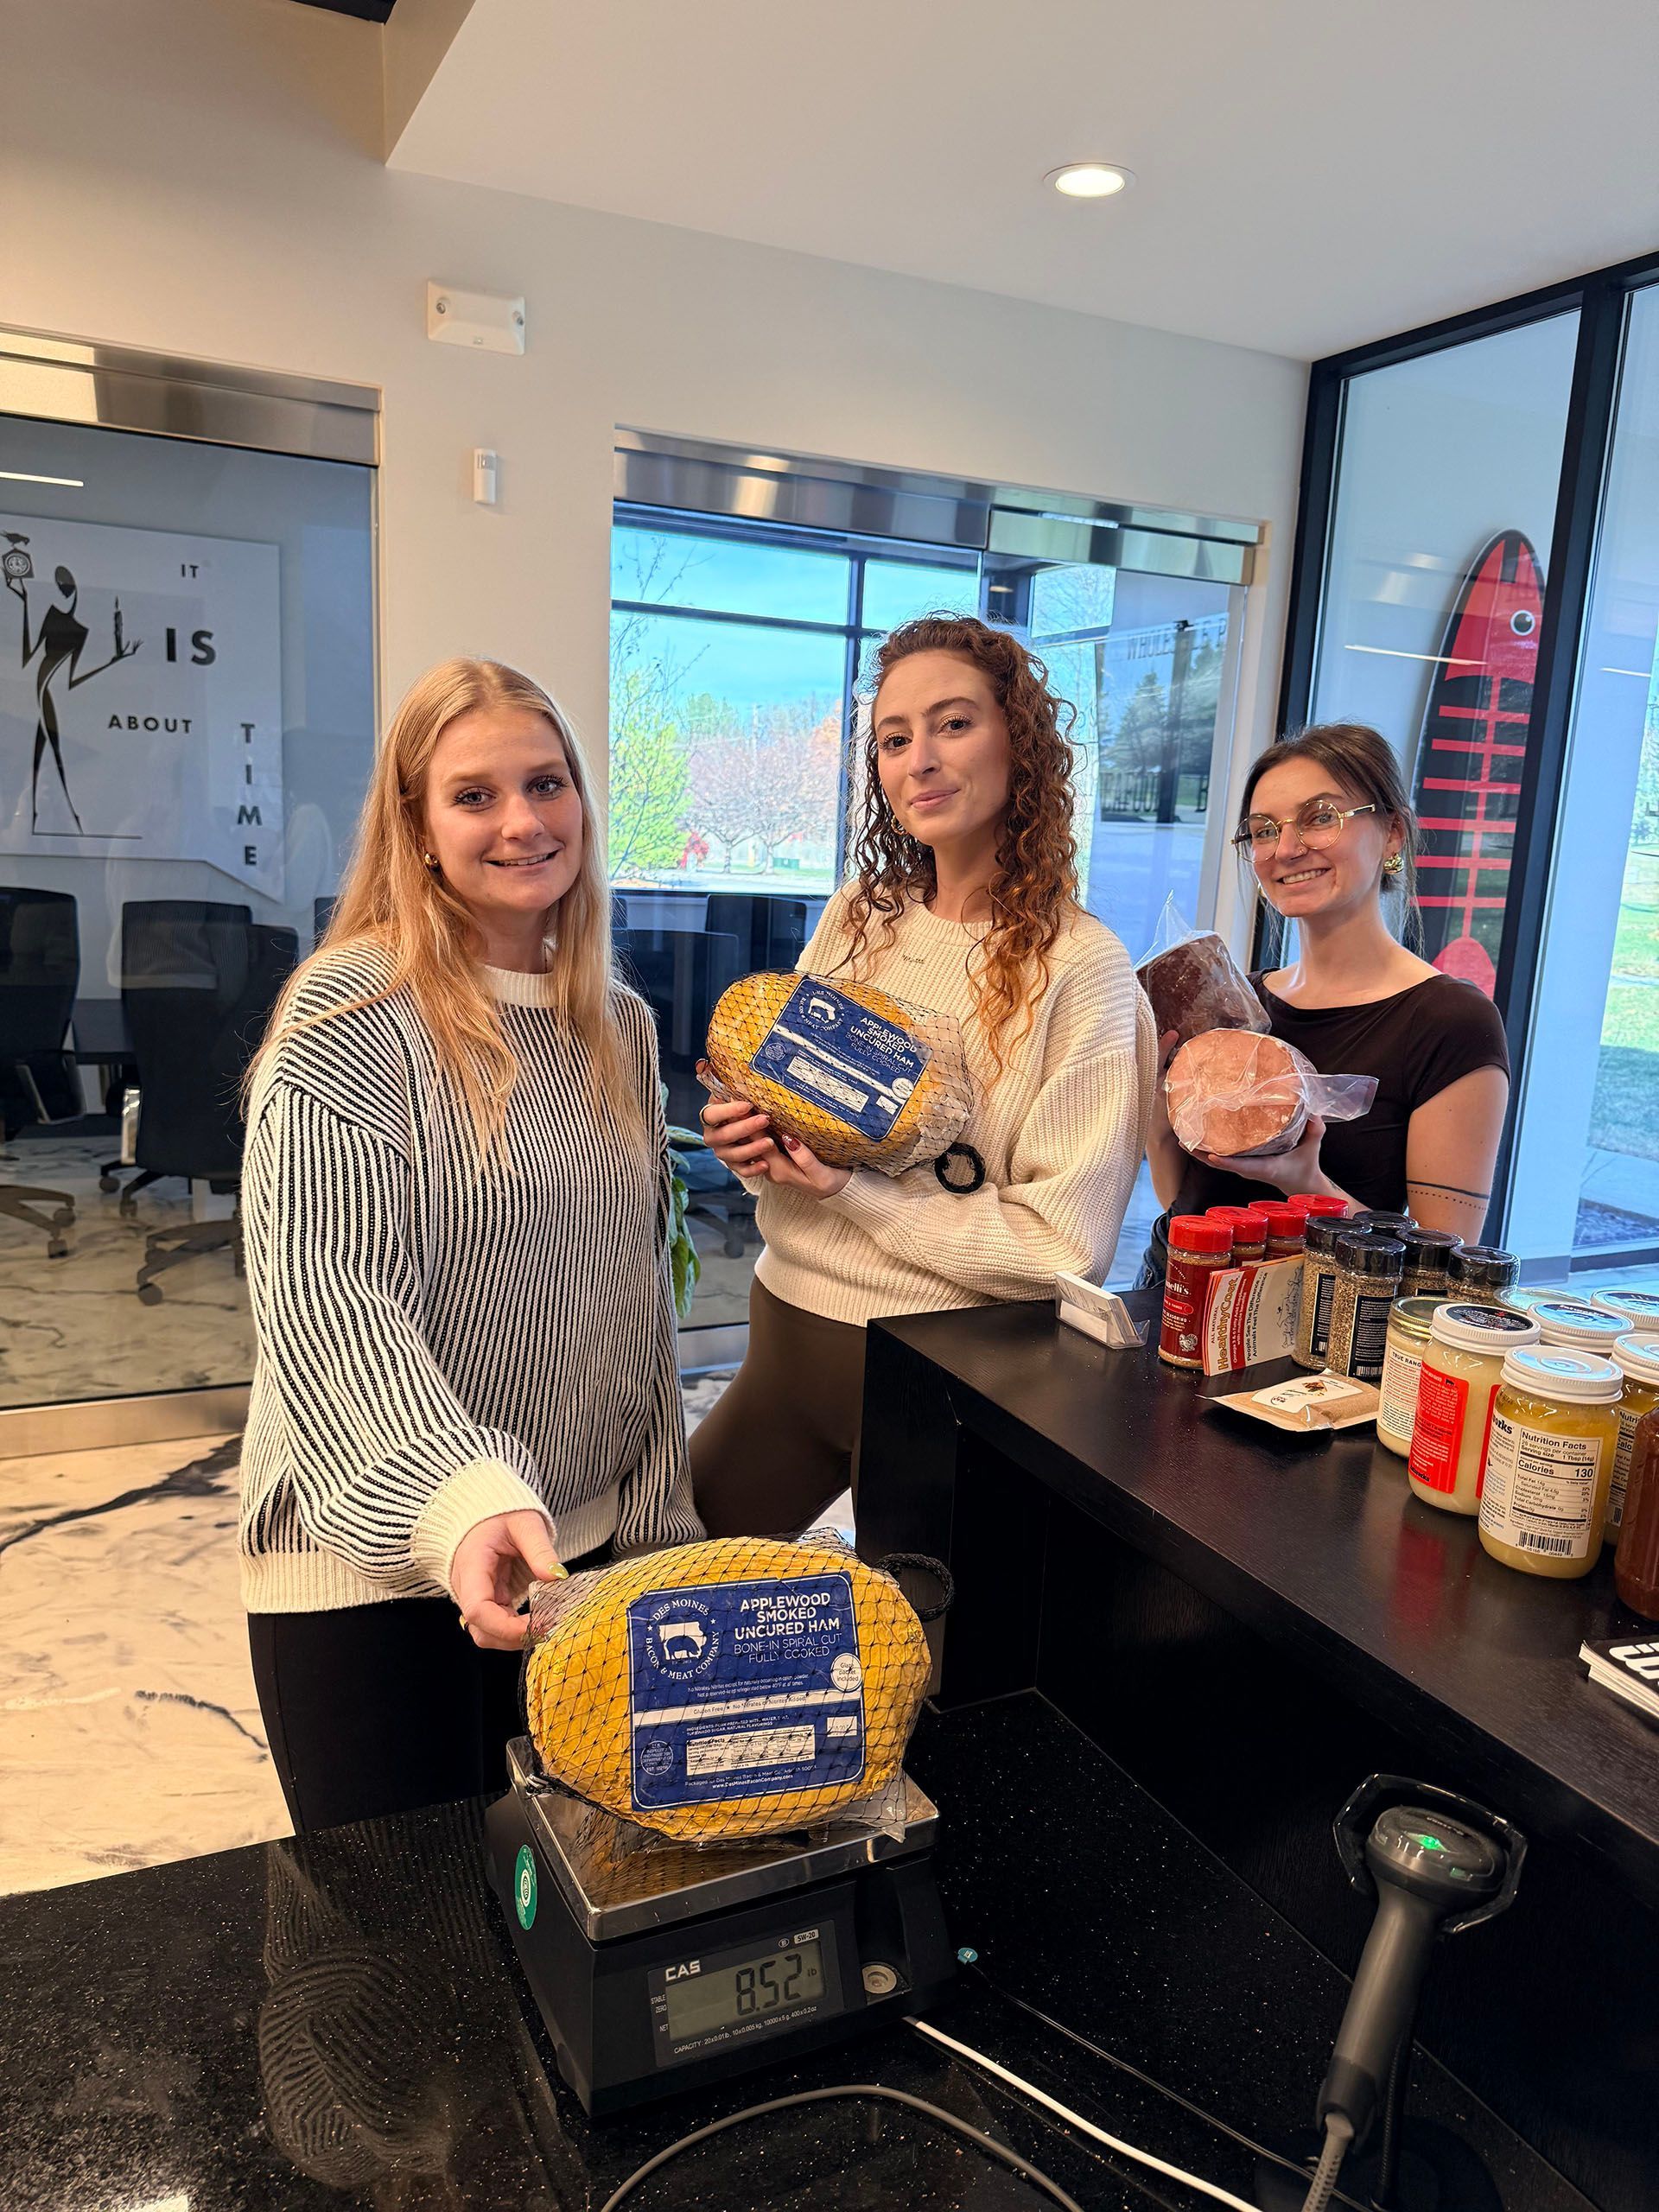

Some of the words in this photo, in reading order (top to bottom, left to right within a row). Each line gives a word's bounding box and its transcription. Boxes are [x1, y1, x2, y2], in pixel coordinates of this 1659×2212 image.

[181, 564, 199, 579] IT
[166, 627, 216, 665] IS
[108, 714, 193, 734] ABOUT
[238, 722, 263, 866] TIME
[860, 1017, 917, 1053] APPLEWOOD
[868, 1028, 905, 1052] SMOKED
[845, 1032, 874, 1052] BONE-IN
[874, 1050, 896, 1065] SPIRAL
[850, 1026, 893, 1054] UNCURED
[893, 1052, 914, 1068] HAM
[851, 1043, 872, 1056] FULLY
[872, 1055, 900, 1073] COOKED
[1249, 1281, 1260, 1312] Difference
[1255, 1272, 1268, 1304] Difference
[1392, 1351, 1404, 1362] TRUE
[1521, 1445, 1541, 1455] Serving
[1522, 1431, 1560, 1447] Nutrition
[1563, 1440, 1586, 1450] Facts
[1529, 1442, 1552, 1452] servings
[1518, 1459, 1554, 1475] Calories
[1575, 1468, 1593, 1478] 130
[1515, 1491, 1532, 1499] Sodium
[1516, 1485, 1540, 1496] Cholesterol
[1521, 1481, 1541, 1491] Saturated
[1513, 1501, 1529, 1510] Protein
[1525, 1499, 1556, 1510] Carbohydrate
[653, 1604, 671, 1621] DES
[671, 1599, 709, 1616] MOINES
[741, 1592, 830, 1612] APPLEWOOD
[757, 1607, 817, 1624] SMOKED
[734, 1624, 804, 1641] UNCURED
[809, 1618, 840, 1633] HAM
[734, 1640, 779, 1656] BONE-IN
[782, 1636, 818, 1650] SPIRAL
[820, 1632, 842, 1646] CUT
[645, 1637, 659, 1669] BACON
[668, 1669, 694, 1680] MEAT
[696, 1631, 720, 1675] COMPANY
[748, 1651, 780, 1663] FULLY
[797, 1931, 817, 1942] SW-20
[665, 1960, 701, 1982] CAS
[735, 1953, 802, 2017] 8.52
[808, 1966, 817, 1977] lb
[651, 1993, 666, 2005] STABLE
[655, 2005, 667, 2014] ZERO
[659, 2024, 669, 2032] NET
